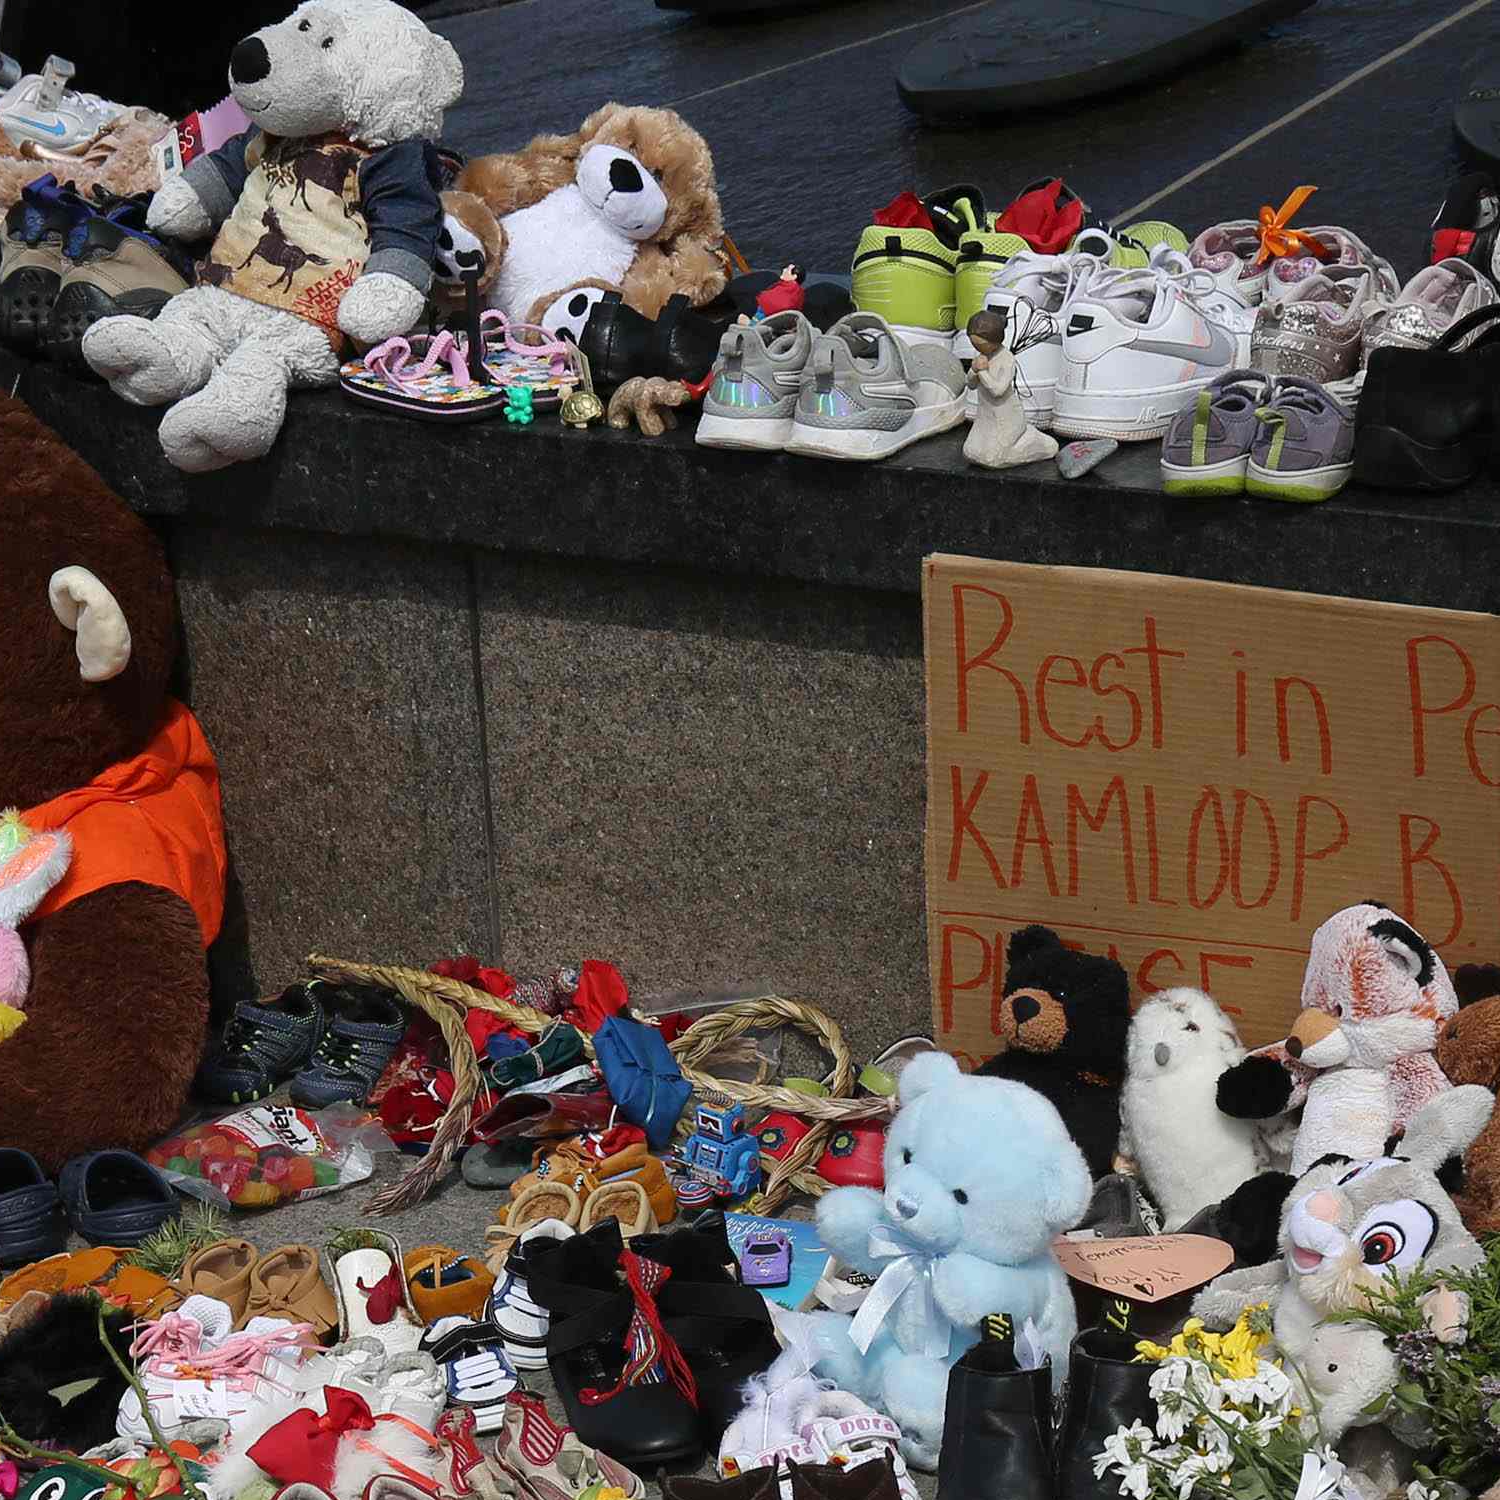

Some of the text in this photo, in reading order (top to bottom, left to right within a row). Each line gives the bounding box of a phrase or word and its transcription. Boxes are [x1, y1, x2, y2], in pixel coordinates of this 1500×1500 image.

[951, 583, 1185, 753] Rest
[1233, 648, 1333, 776] in
[947, 764, 1350, 923] KAMLOOP
[938, 922, 1254, 1036] PLSE
